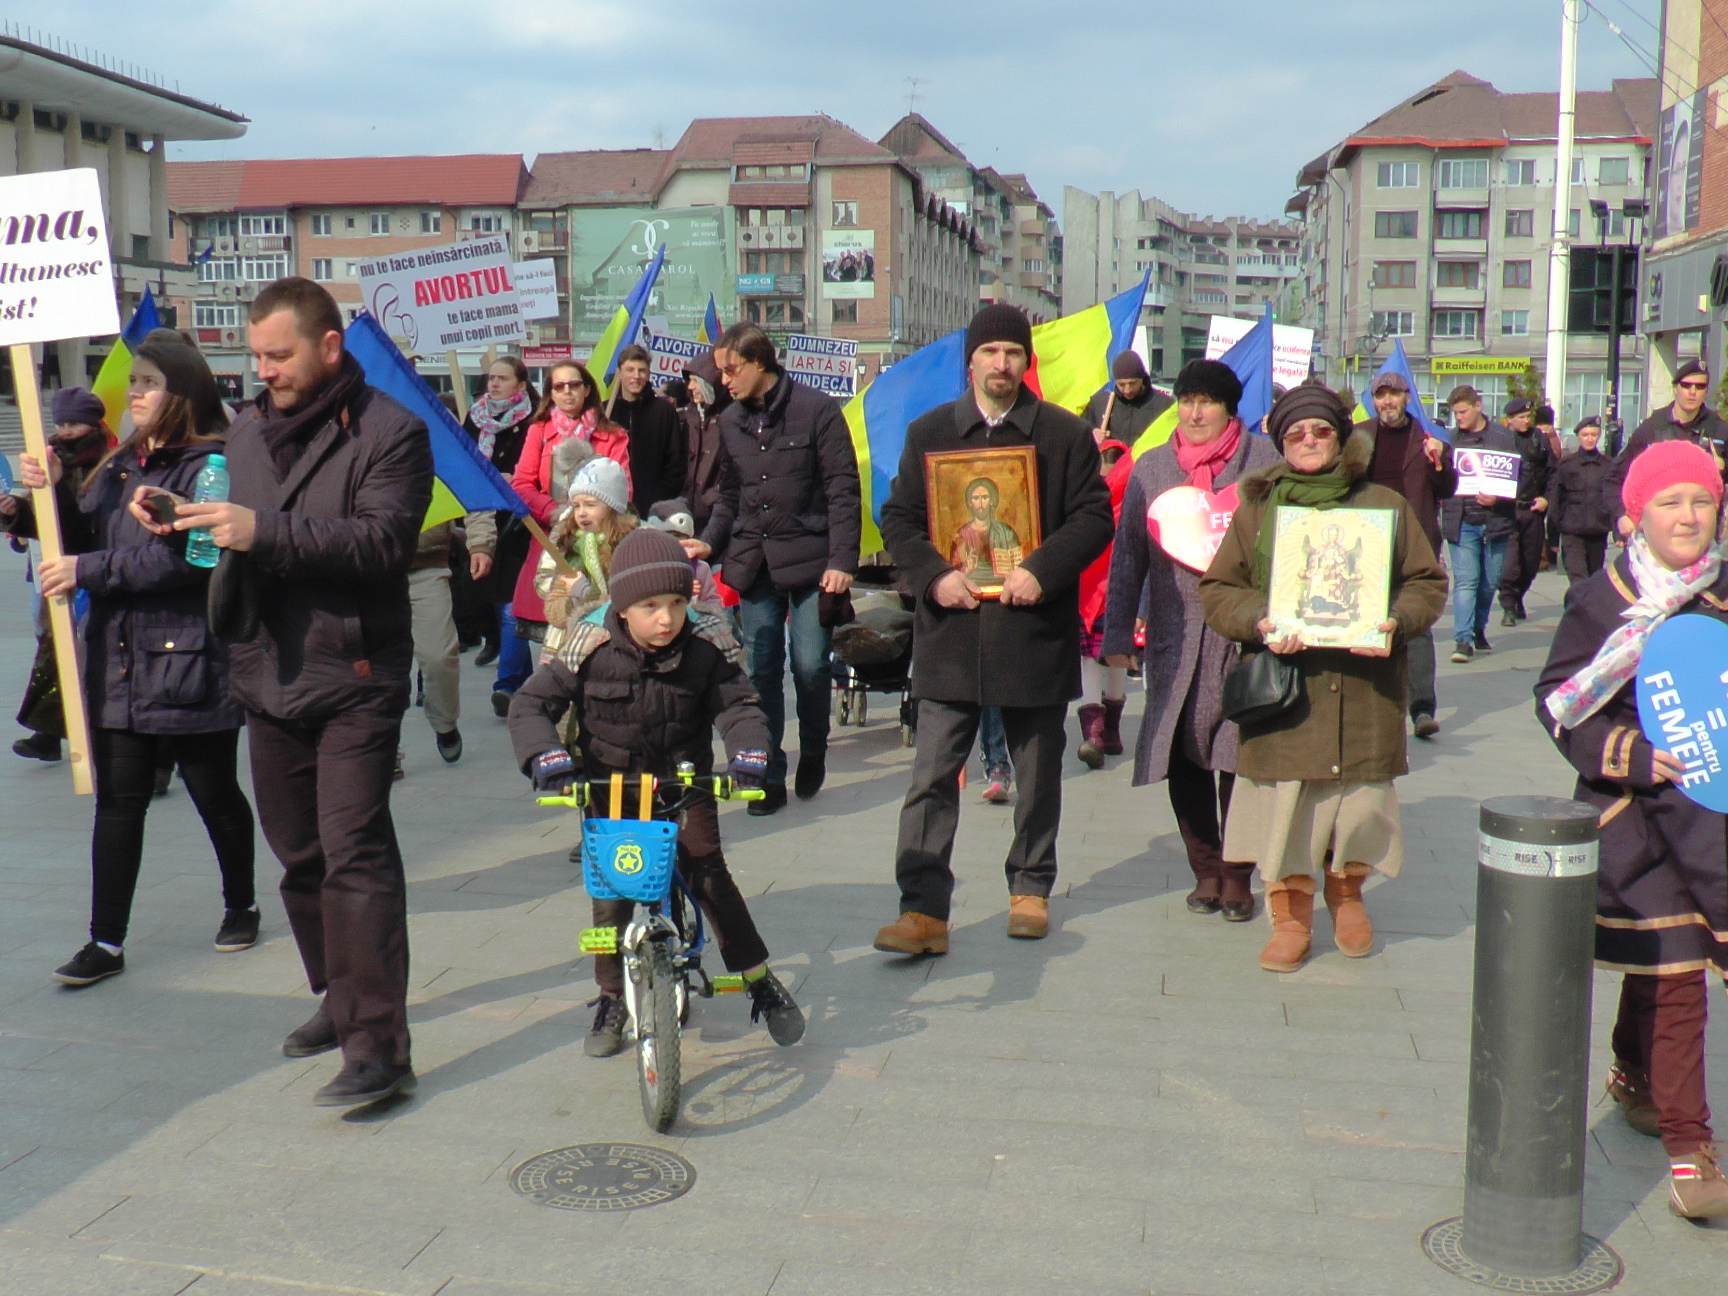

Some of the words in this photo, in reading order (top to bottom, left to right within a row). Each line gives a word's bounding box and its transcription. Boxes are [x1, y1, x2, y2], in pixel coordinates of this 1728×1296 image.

[0, 209, 98, 246] ma,
[360, 263, 375, 277] nu
[376, 261, 388, 274] te
[389, 256, 416, 271] face
[608, 265, 643, 275] CASA
[414, 265, 514, 307] AVORTUL
[447, 311, 459, 325] te
[459, 304, 484, 323] face
[485, 303, 519, 318] mama
[440, 329, 464, 345] unui
[465, 324, 493, 341] copil
[493, 320, 523, 338] mort.
[789, 336, 858, 357] DUMNEZEU
[791, 354, 833, 372] IARTĂ
[839, 359, 852, 377] ȘI
[1446, 361, 1496, 370] Raiffeisen
[1498, 361, 1526, 370] BANK
[788, 372, 850, 392] VINDECĂ
[1482, 454, 1513, 470] 80%
[1644, 670, 1711, 788] FEMEIE
[1690, 720, 1722, 773] pentru
[1515, 852, 1538, 864] RISE
